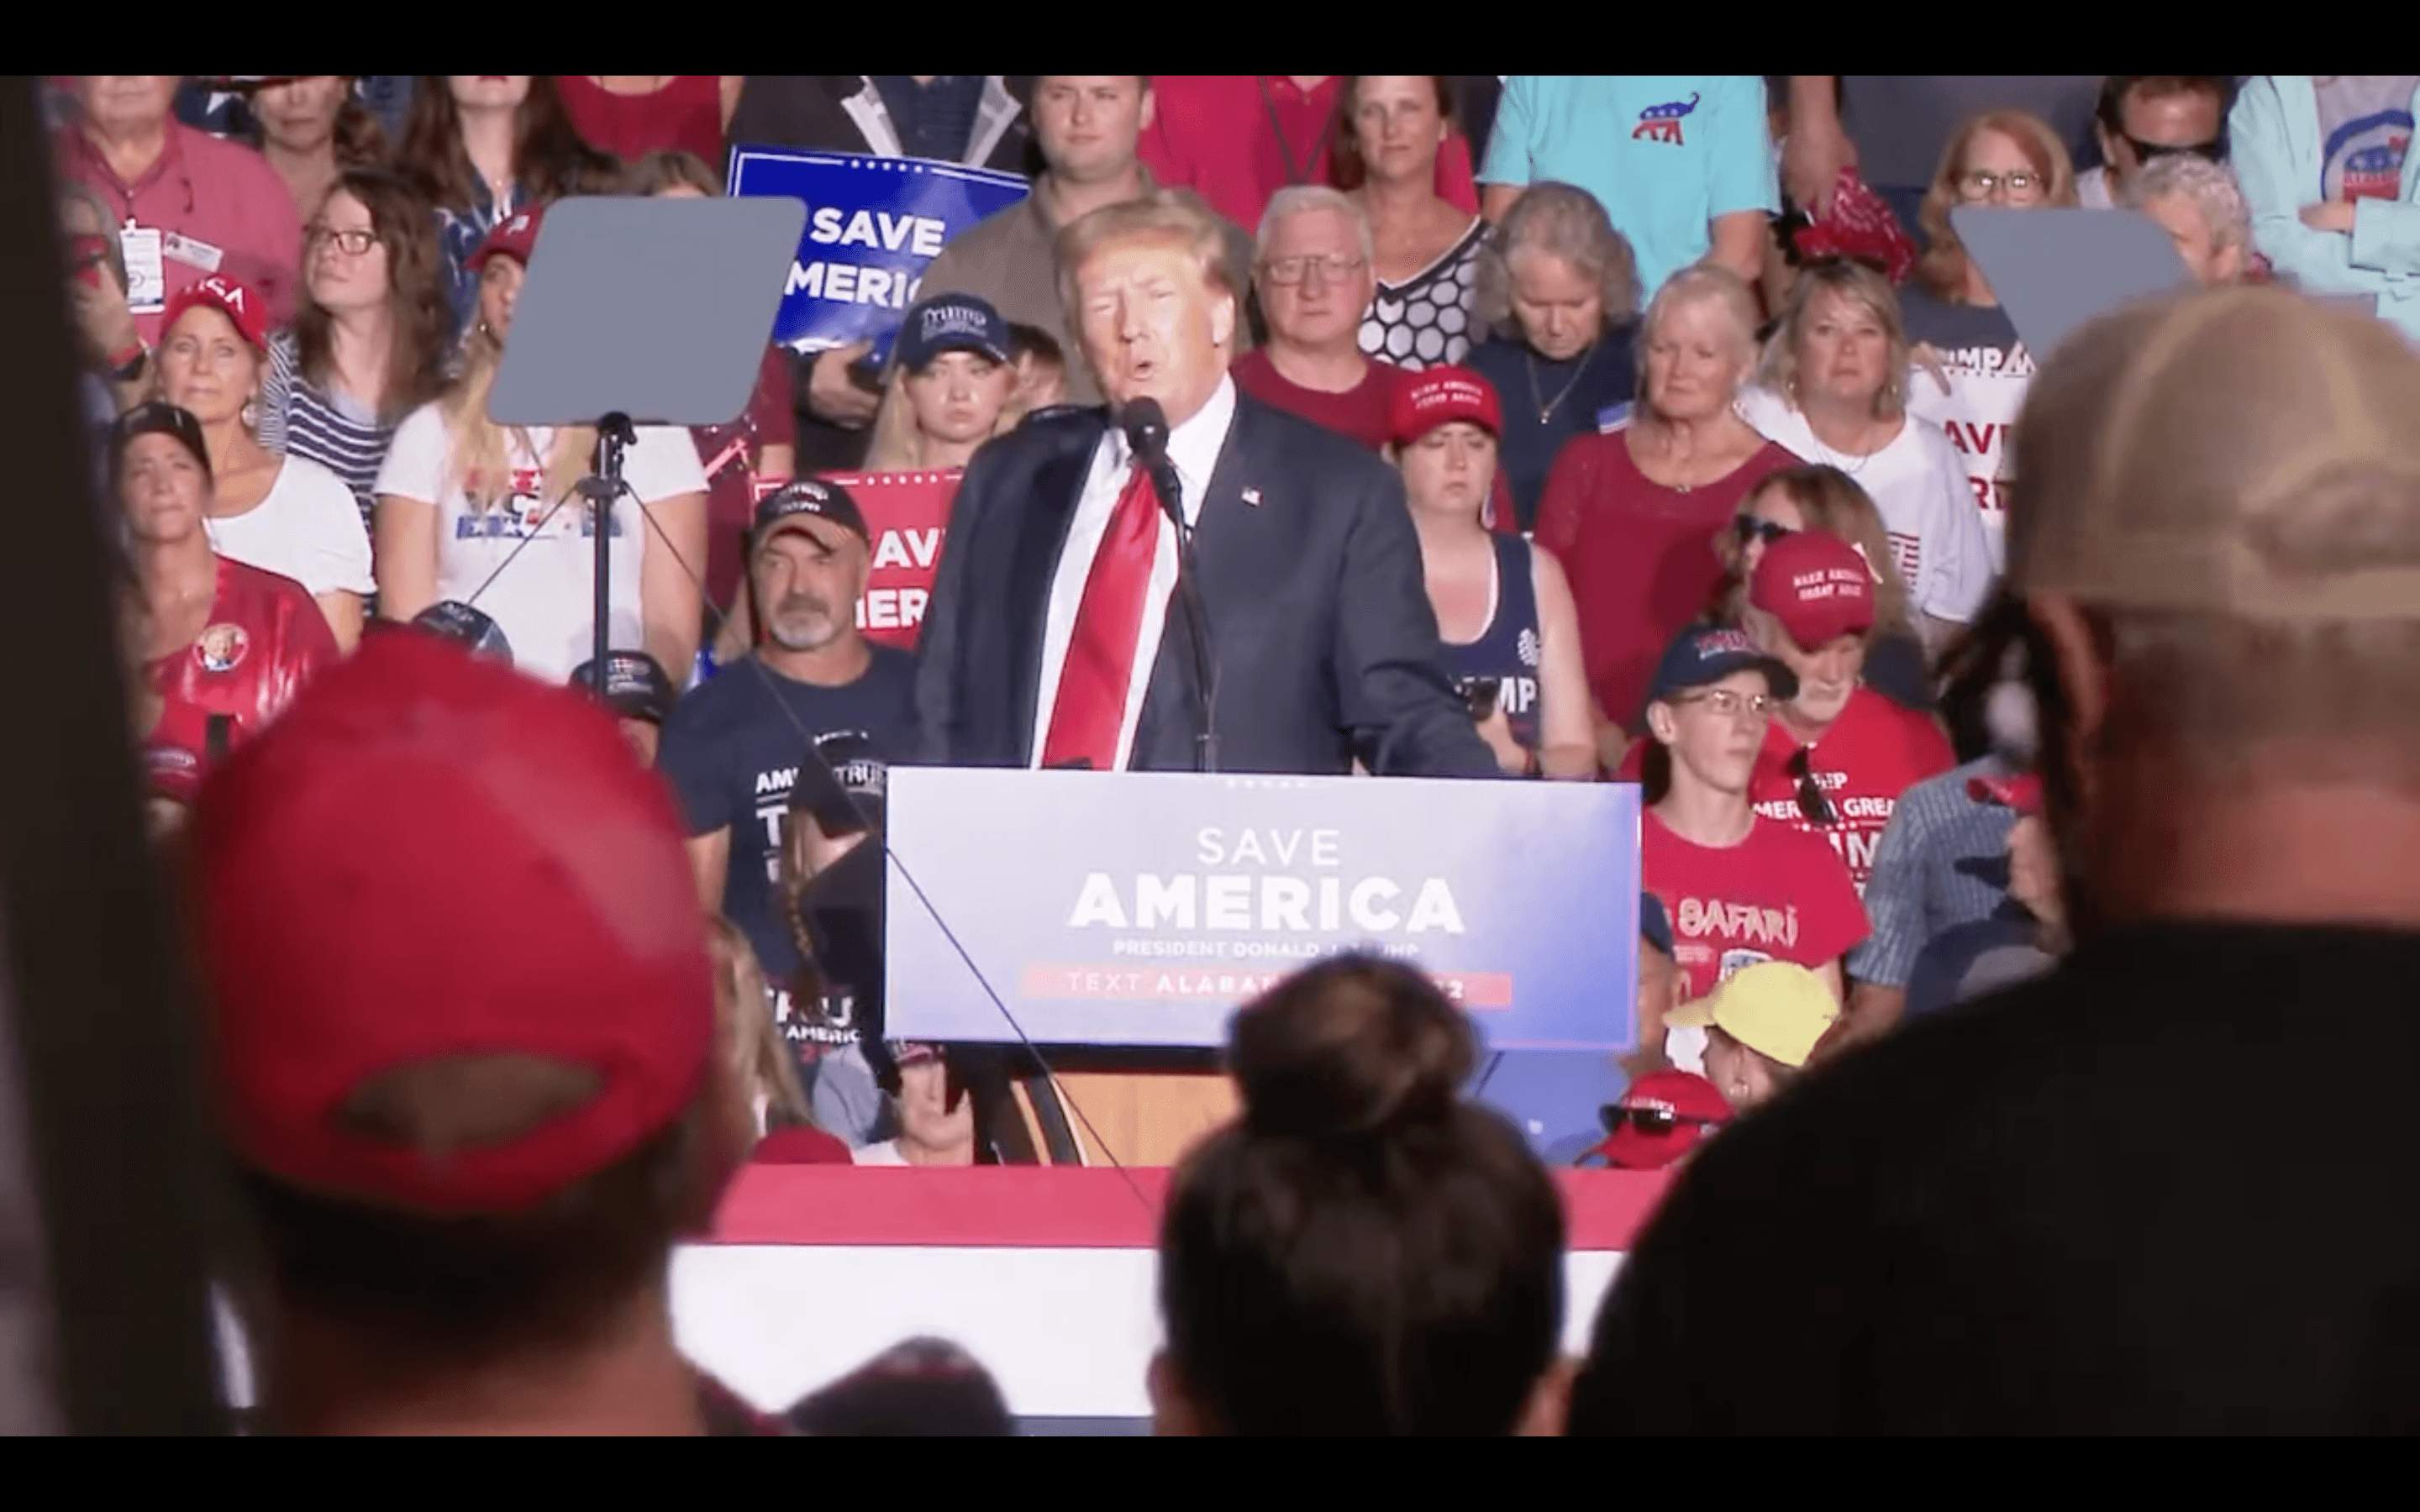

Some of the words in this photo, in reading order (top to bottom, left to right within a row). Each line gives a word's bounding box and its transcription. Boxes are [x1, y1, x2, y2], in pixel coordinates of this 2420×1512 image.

[809, 206, 945, 258] SAVE
[1197, 827, 1340, 866] SAVE
[1066, 870, 1467, 935] AMERICA
[1113, 938, 1228, 958] PRESIDENT
[1232, 941, 1321, 958] DONALD
[1066, 971, 1141, 992] TEXT
